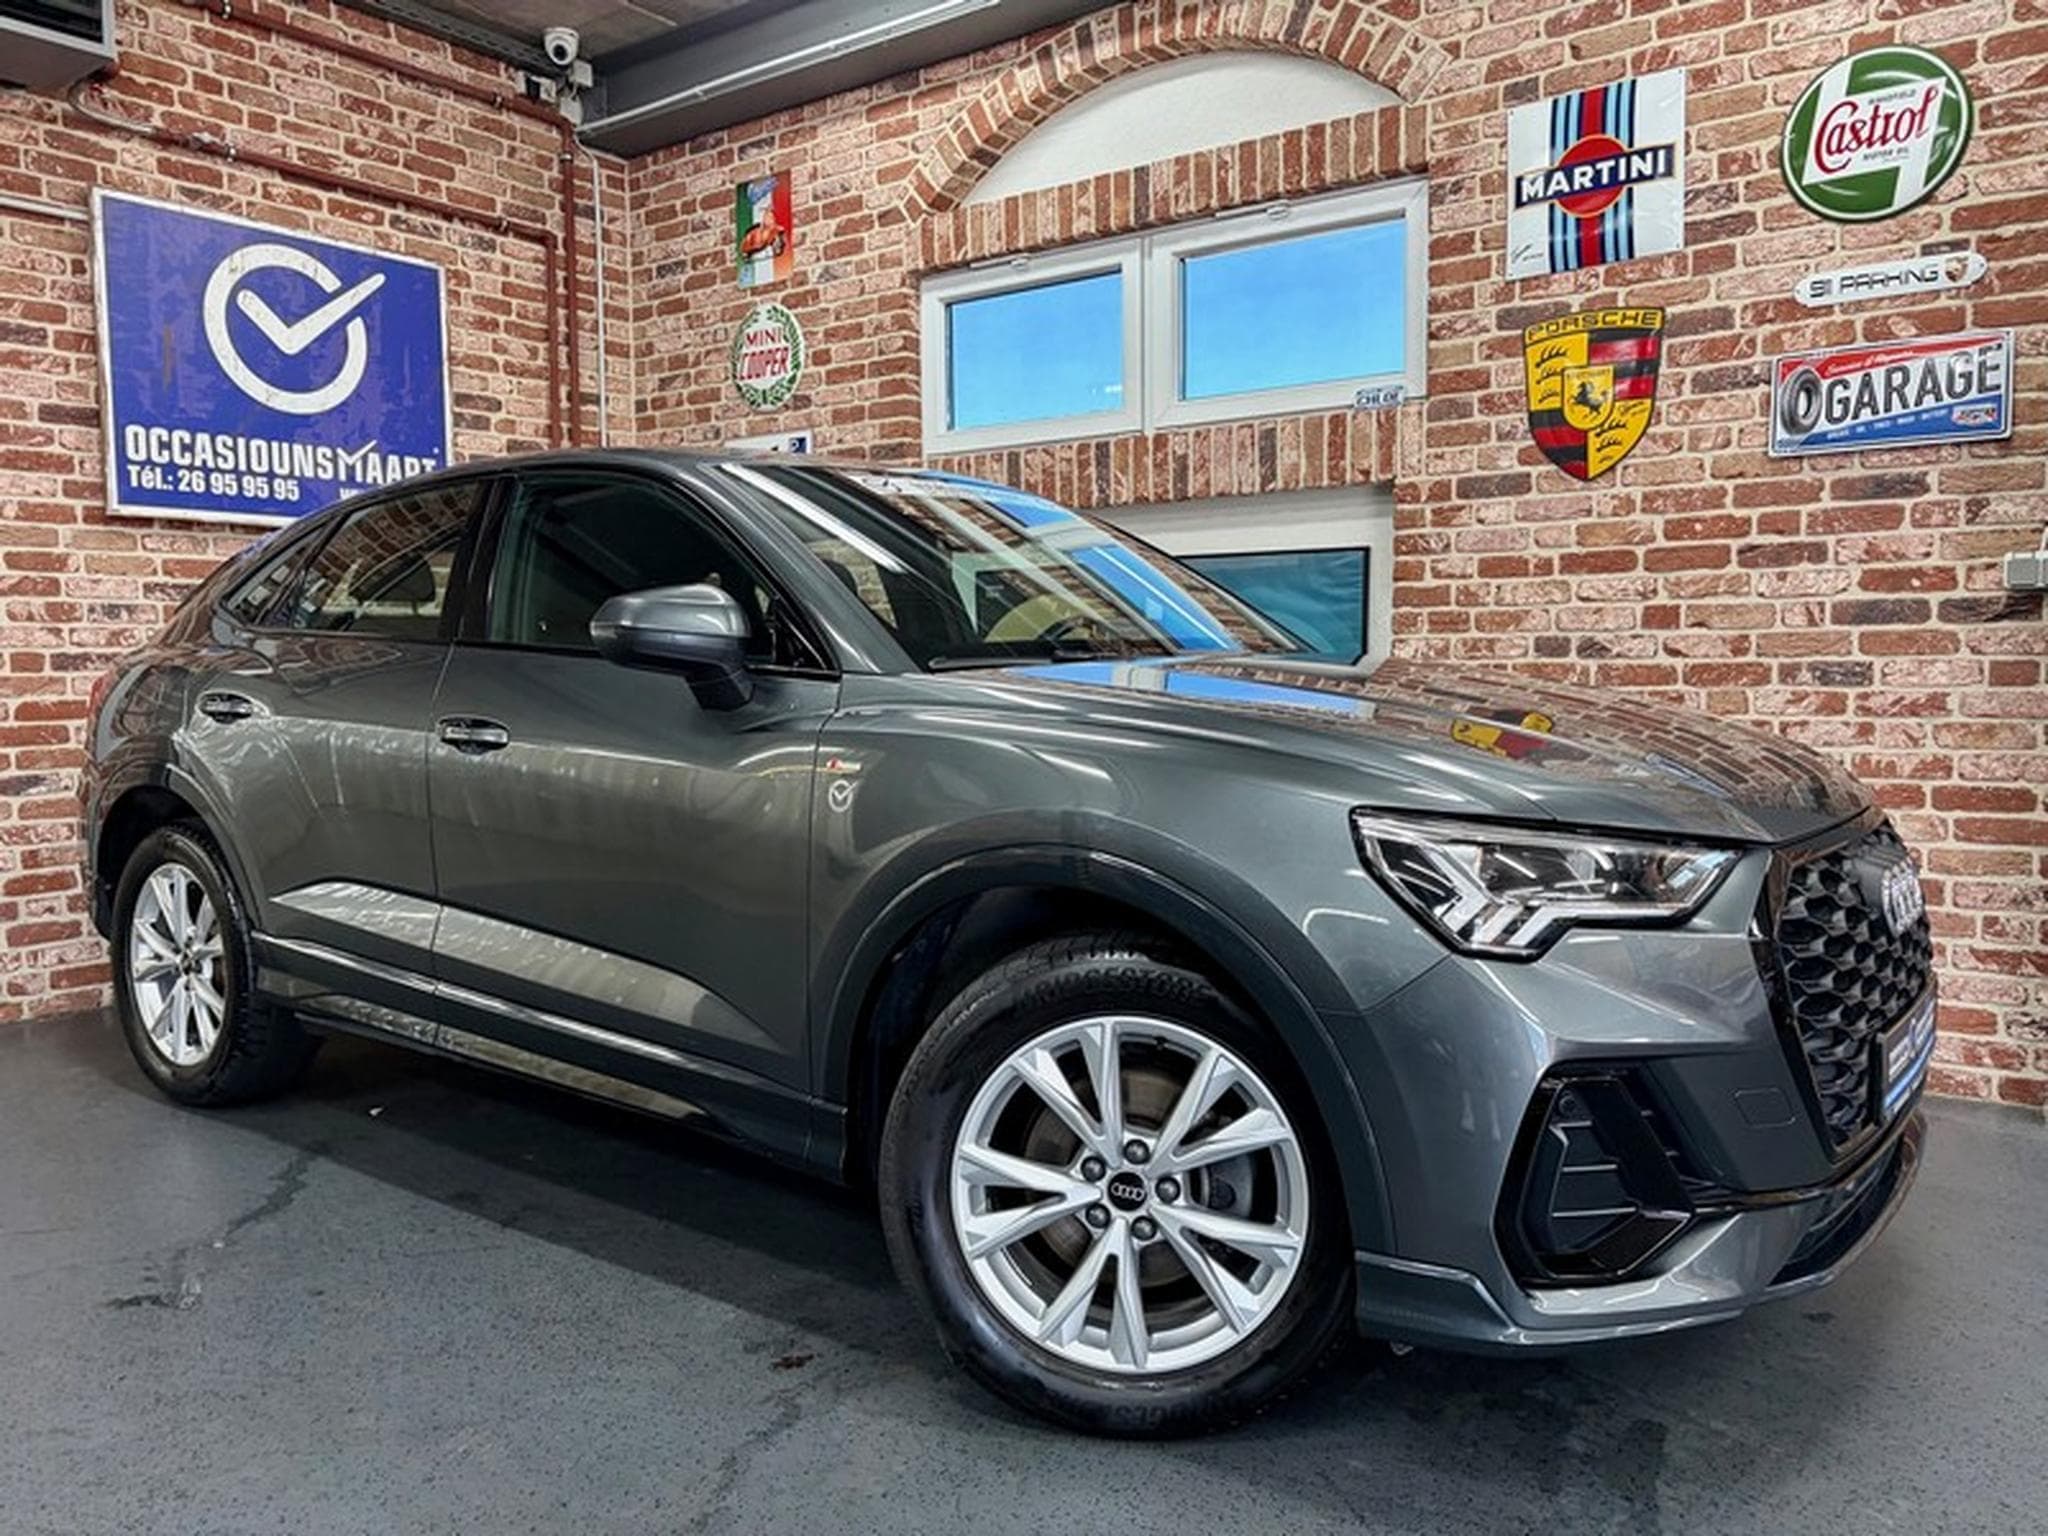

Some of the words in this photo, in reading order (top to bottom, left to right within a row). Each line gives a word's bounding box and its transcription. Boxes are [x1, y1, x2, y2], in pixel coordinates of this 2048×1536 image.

[1814, 85, 1939, 174] Castrol
[1521, 149, 1666, 203] MARTINI
[1840, 263, 1938, 294] PARKING
[745, 327, 781, 347] MINI
[1528, 311, 1658, 341] PORSCHE
[737, 347, 790, 381] COOPER
[1824, 343, 2003, 425] GARAGE
[127, 464, 173, 491] Tél.:
[177, 469, 205, 493] 26
[209, 472, 238, 496] 95
[242, 475, 269, 499] 95
[273, 477, 300, 501] 95
